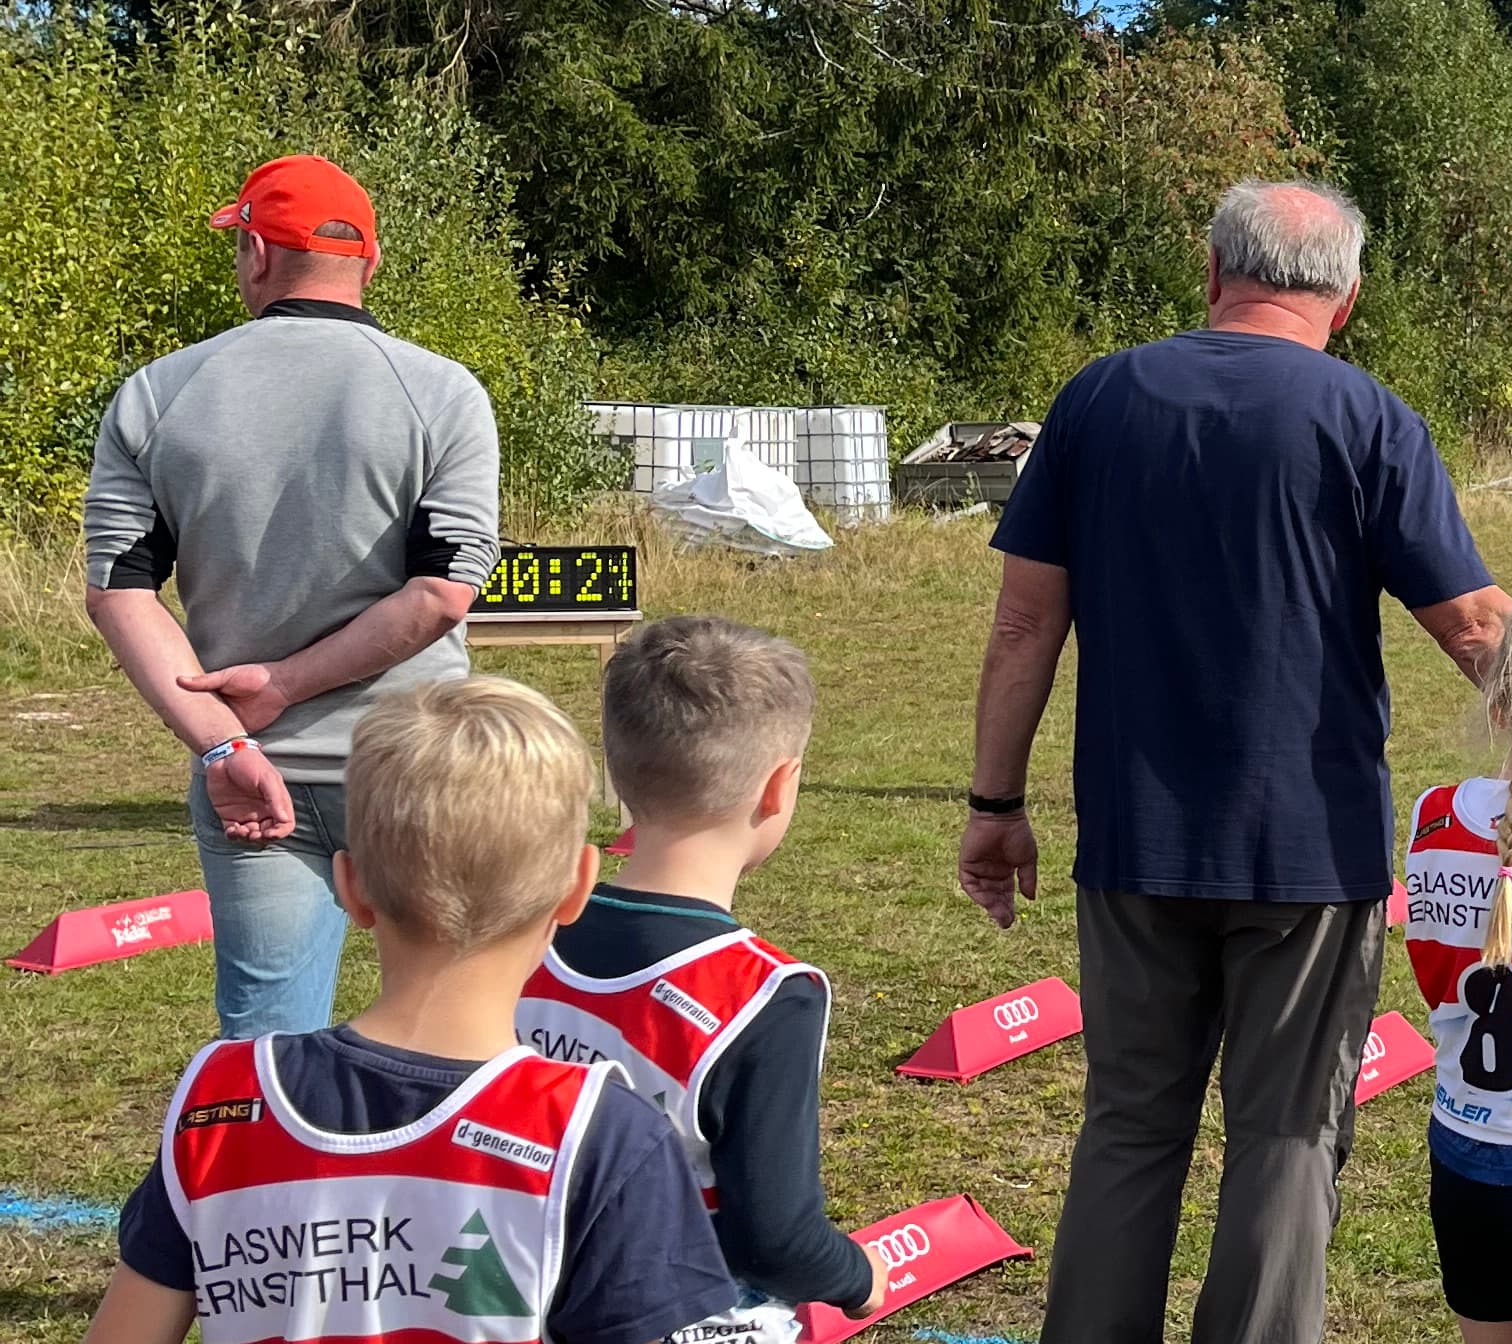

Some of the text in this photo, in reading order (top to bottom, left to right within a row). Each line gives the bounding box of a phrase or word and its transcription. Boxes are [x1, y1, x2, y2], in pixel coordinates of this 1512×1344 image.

[655, 982, 717, 1031] d-generation
[457, 1122, 552, 1166] d-generation
[193, 1217, 414, 1273] LASWERK
[889, 1271, 918, 1293] Audi
